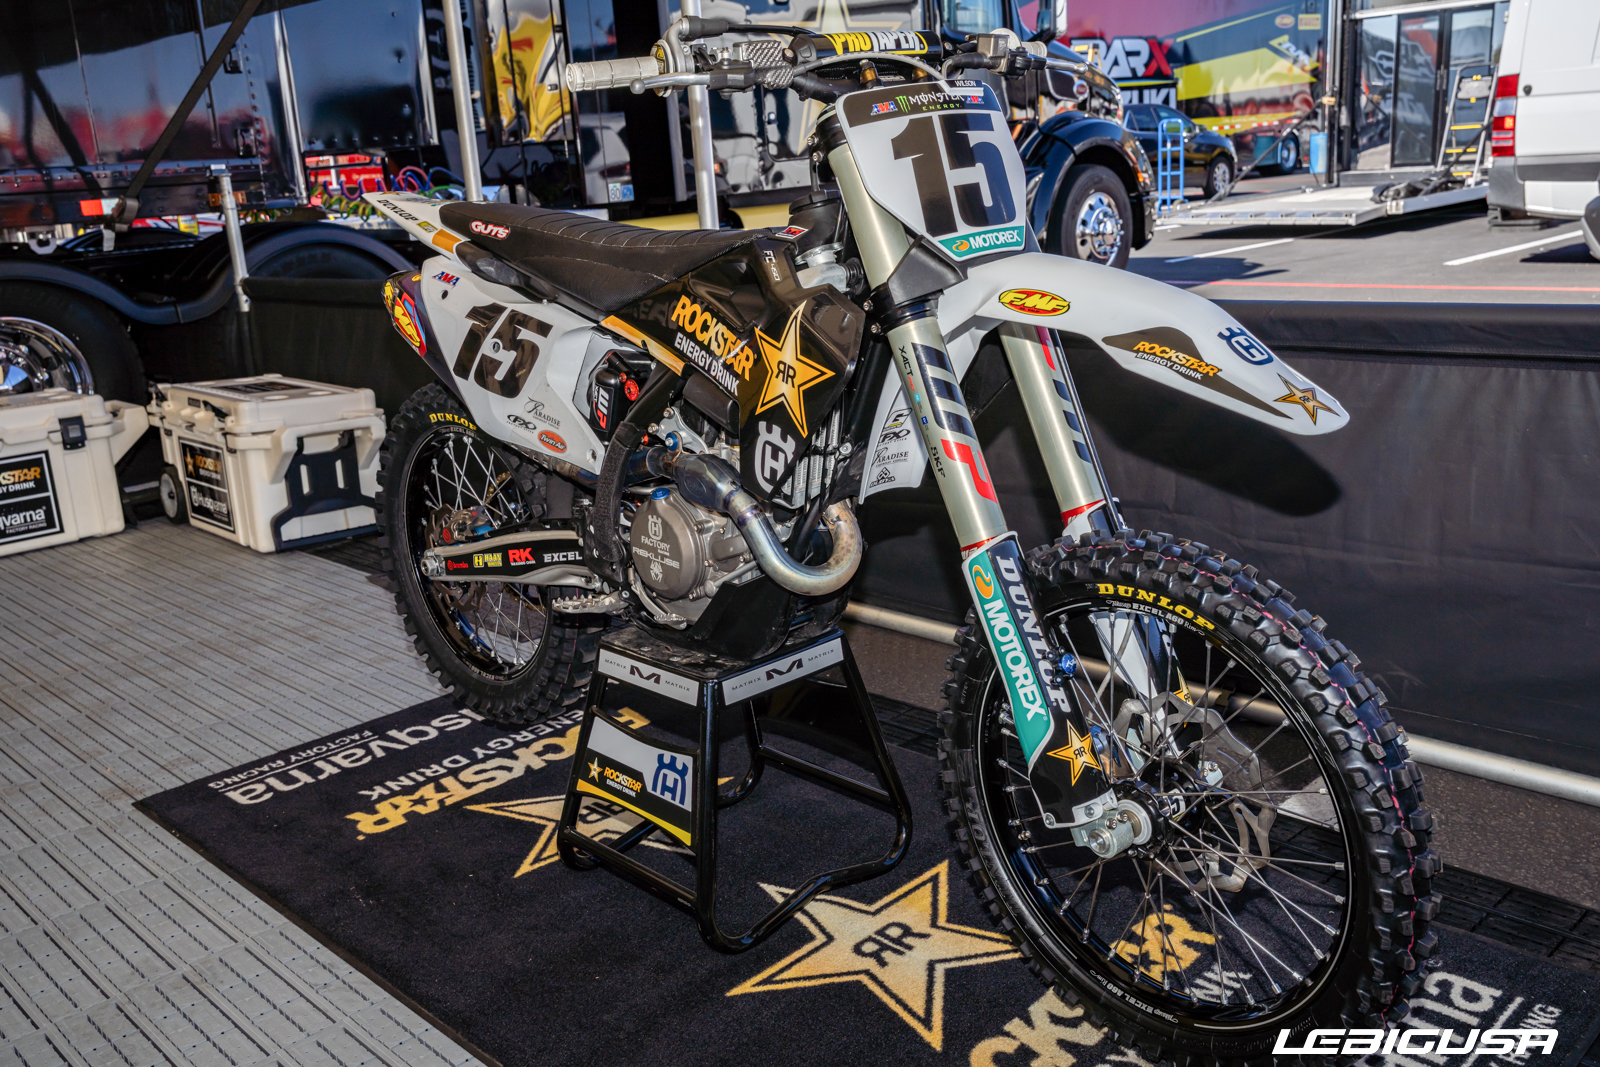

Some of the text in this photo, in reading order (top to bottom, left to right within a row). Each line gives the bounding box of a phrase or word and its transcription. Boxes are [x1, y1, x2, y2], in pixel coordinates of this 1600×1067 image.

[871, 101, 897, 115] AMA
[922, 103, 963, 111] ENERGY
[890, 113, 1017, 238] 15
[377, 199, 419, 221] DUNLOP
[470, 220, 510, 239] GUTS
[969, 229, 1021, 249] MOTOREX
[432, 271, 460, 287] AMA
[998, 291, 1071, 311] FMF
[671, 295, 755, 381] ROCKSTAR
[453, 302, 553, 399] 15
[899, 345, 914, 376] XACT
[1133, 341, 1221, 377] ROCKSTAR
[674, 332, 740, 396] ENERGY DRINK
[1136, 352, 1204, 380] ENERGY DRINK
[429, 413, 477, 431] DUNLOP
[524, 397, 561, 427] PARADISE
[540, 432, 566, 451] Twin Air
[871, 447, 909, 467] PARADISE
[930, 446, 946, 478] SKF
[9, 481, 36, 492] DRINK
[641, 535, 670, 552] FACTORY
[484, 553, 502, 562] HAAN
[508, 548, 534, 563] RK
[543, 551, 583, 562] EXCEL
[632, 546, 680, 569] REKLUSE
[1097, 583, 1215, 630] DUNLOP
[1132, 603, 1165, 618] EXCEL
[1165, 613, 1184, 625] A60
[995, 555, 1071, 714] DUNLOP
[731, 676, 762, 690] MATRIX
[808, 649, 835, 661] MATRIX
[984, 598, 1046, 722] MOTOREX
[604, 658, 627, 669] MATRIX
[665, 680, 691, 692] MATRIX
[207, 729, 373, 789] FACTORY RACING
[224, 708, 486, 804] sqvarna
[358, 754, 470, 801] DRINK
[604, 766, 642, 793] ROCKSTAR
[606, 778, 637, 798] ENERGY DRINK
[1106, 983, 1124, 997] A60
[1124, 994, 1154, 1014] EXCEL
